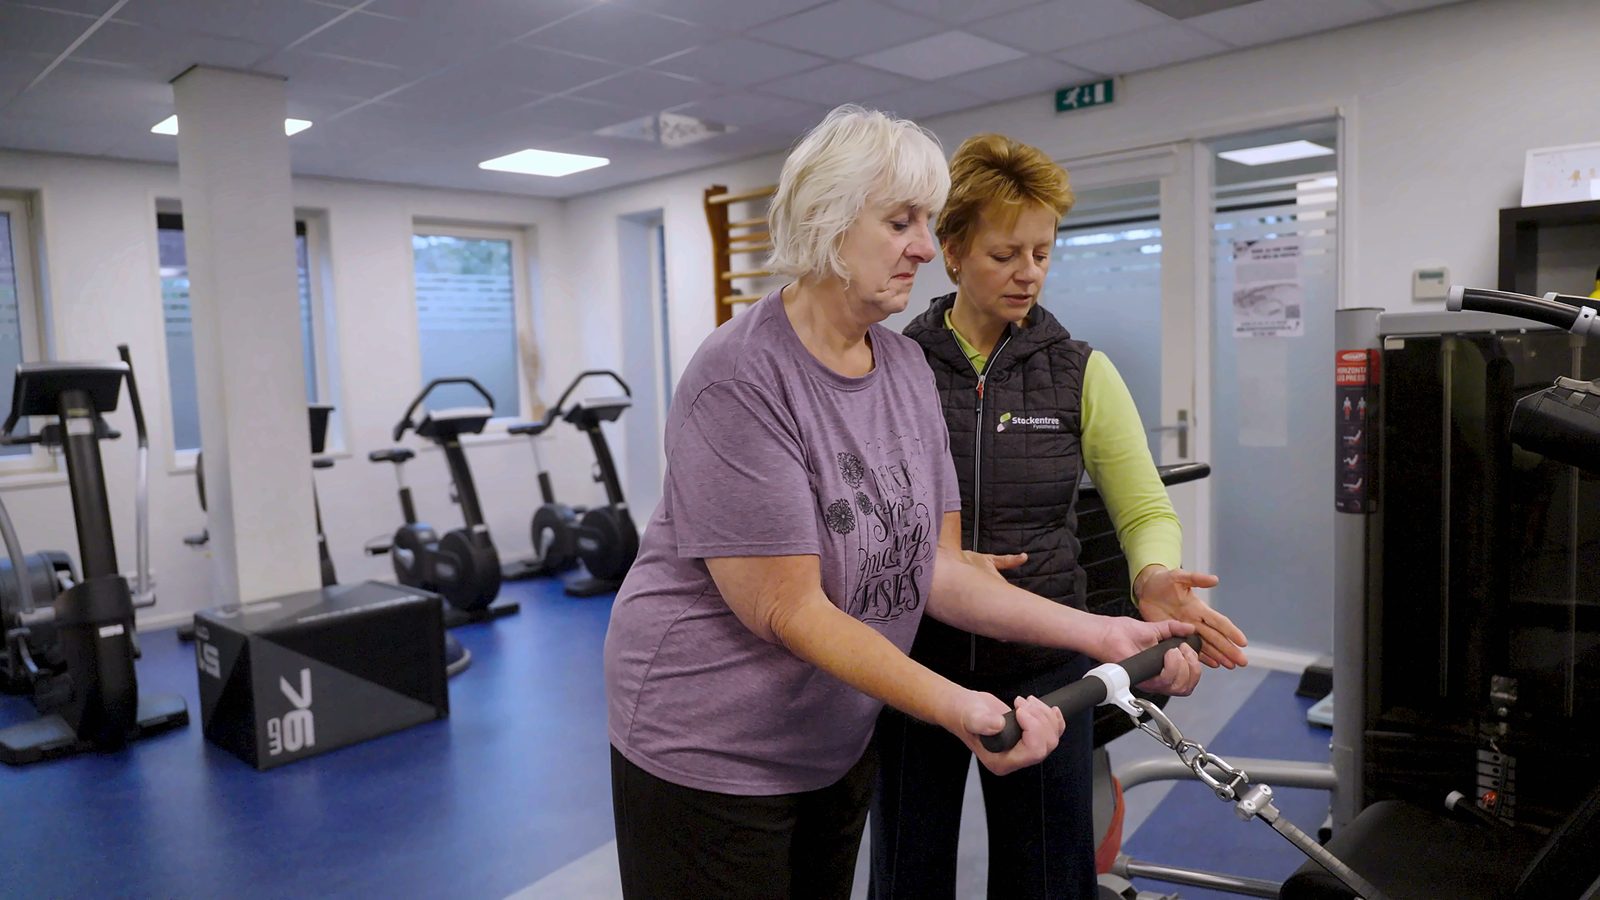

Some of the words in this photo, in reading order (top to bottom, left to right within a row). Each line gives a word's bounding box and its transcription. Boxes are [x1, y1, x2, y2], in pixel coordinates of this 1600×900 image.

[1012, 416, 1060, 424] Stockentree
[279, 668, 316, 752] 76
[267, 717, 283, 756] cm
